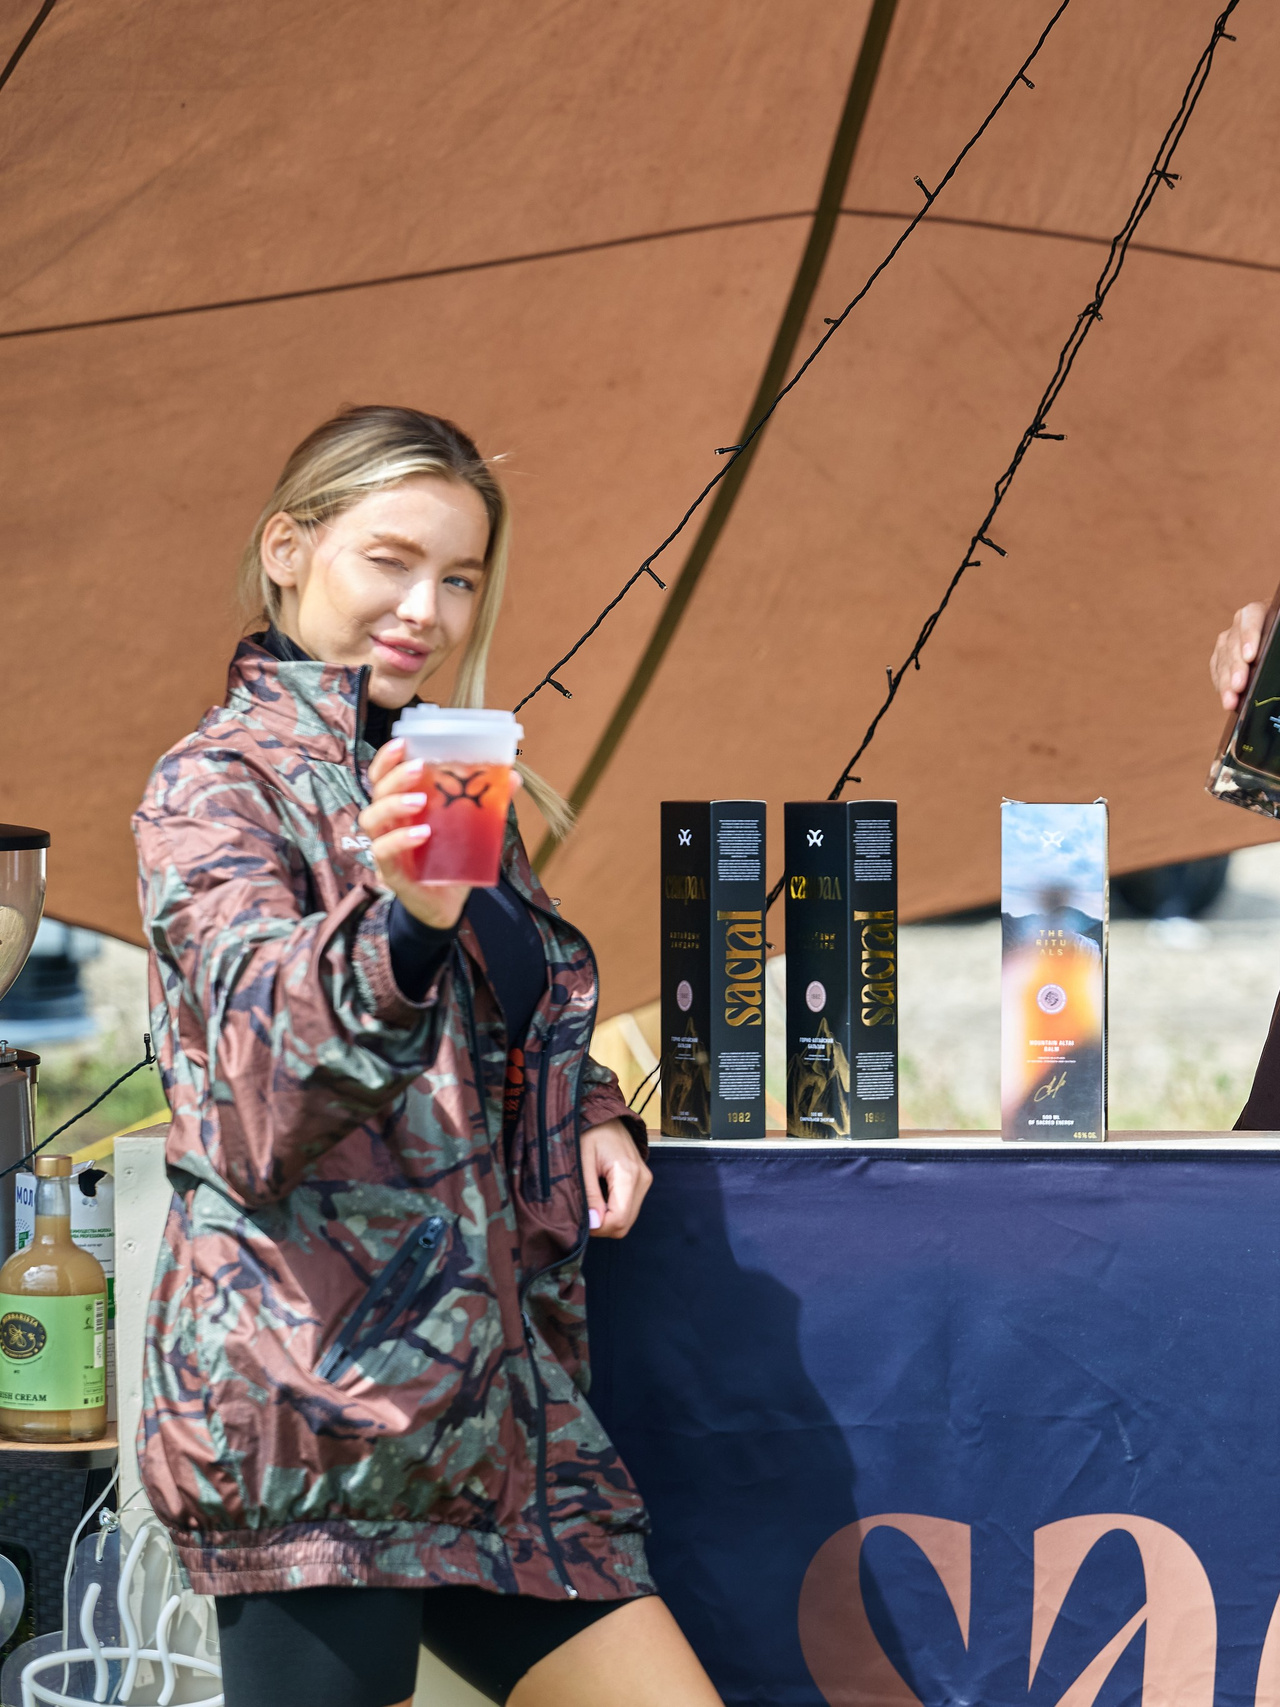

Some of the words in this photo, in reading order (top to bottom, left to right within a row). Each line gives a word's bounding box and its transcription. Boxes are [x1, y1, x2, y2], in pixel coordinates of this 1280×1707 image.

[1039, 929, 1064, 937] THE
[717, 910, 762, 1026] sacral
[853, 910, 896, 1026] sacral
[727, 1112, 751, 1123] 1982
[15, 1393, 47, 1402] CREAM
